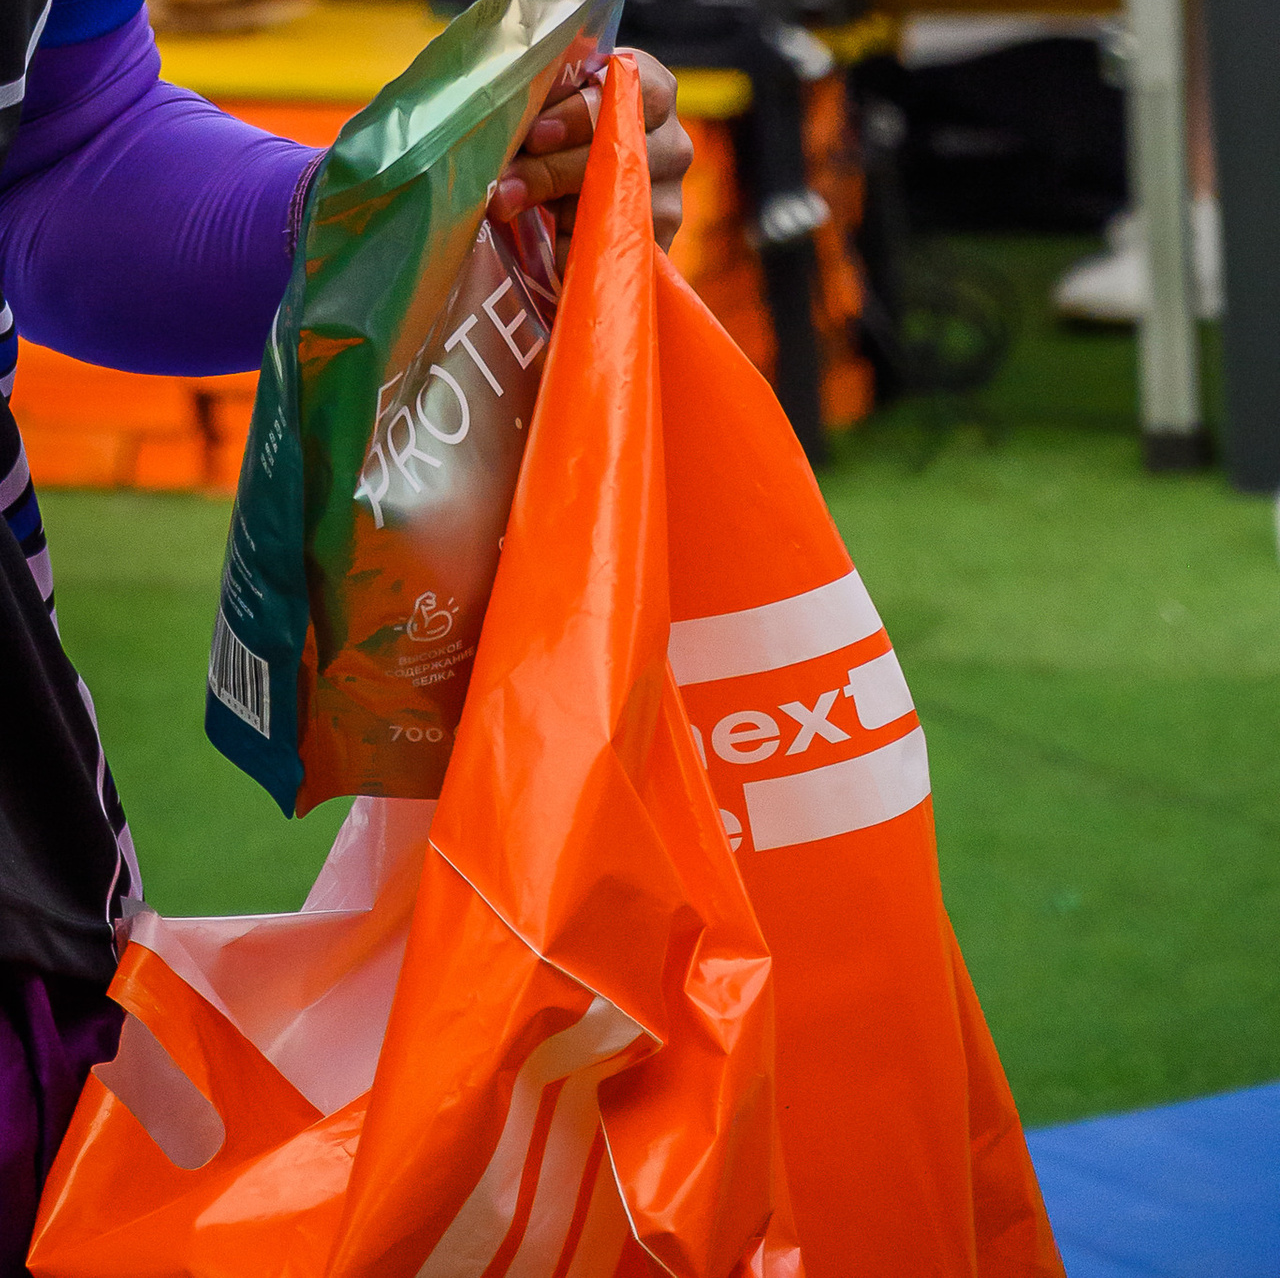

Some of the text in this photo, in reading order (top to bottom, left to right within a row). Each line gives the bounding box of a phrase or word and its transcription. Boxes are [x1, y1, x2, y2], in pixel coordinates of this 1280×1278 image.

[385, 646, 476, 678] СОДЕРЖАНИЕ
[398, 640, 463, 666] ВЫСОКОЕ
[413, 669, 455, 687] БЕЛКА
[388, 725, 444, 743] 700
